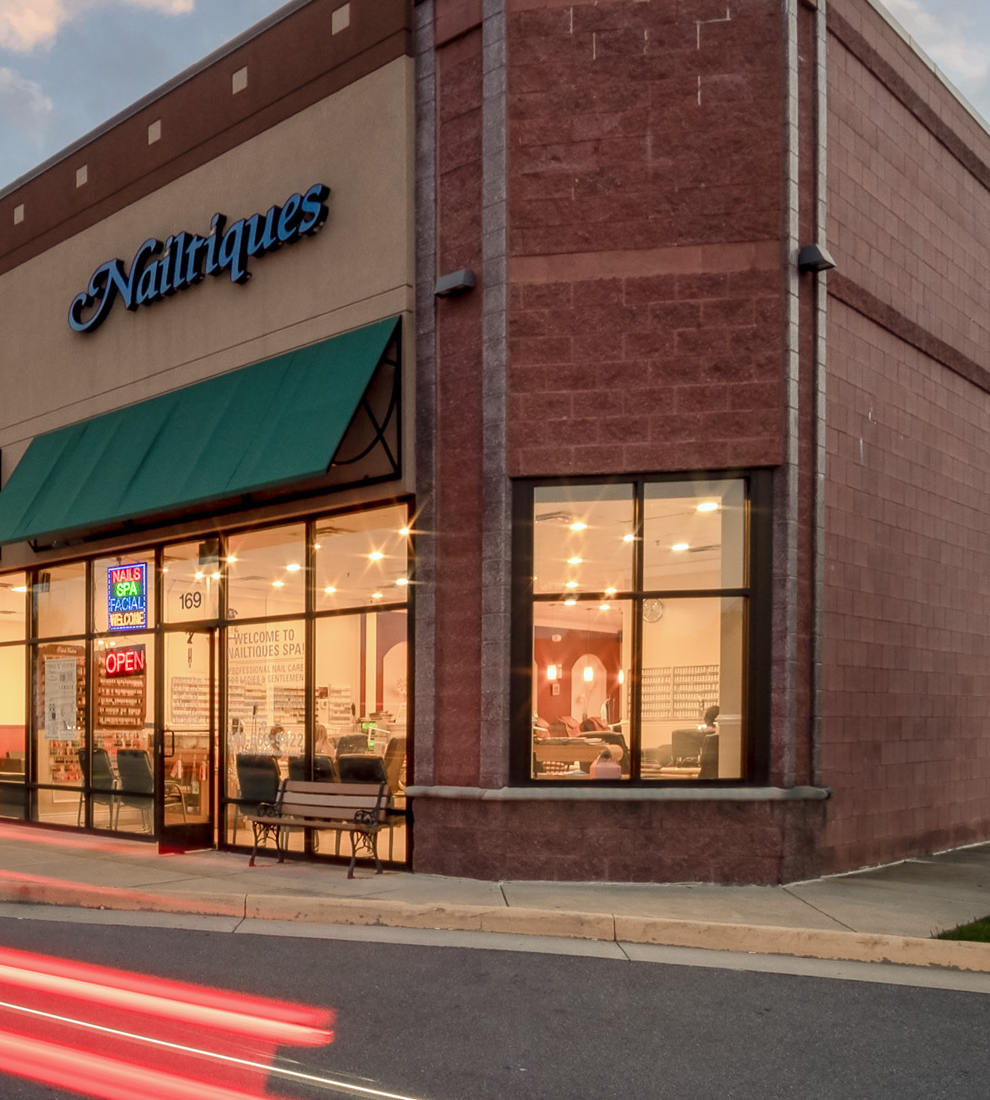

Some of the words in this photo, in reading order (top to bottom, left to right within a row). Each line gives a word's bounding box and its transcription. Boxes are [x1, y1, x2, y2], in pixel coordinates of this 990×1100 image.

[111, 567, 142, 584] NAILS
[116, 581, 138, 597] SPA
[110, 596, 144, 612] FACIAL
[179, 591, 202, 610] 169
[110, 611, 144, 627] WELCOME
[234, 630, 280, 645] WELCOME
[283, 629, 295, 641] TO
[227, 644, 280, 659] NAILTIQUES
[106, 649, 144, 673] OPEN
[272, 665, 286, 674] NAIL
[288, 664, 304, 673] CARE
[267, 673, 304, 683] GENTLEMEN
